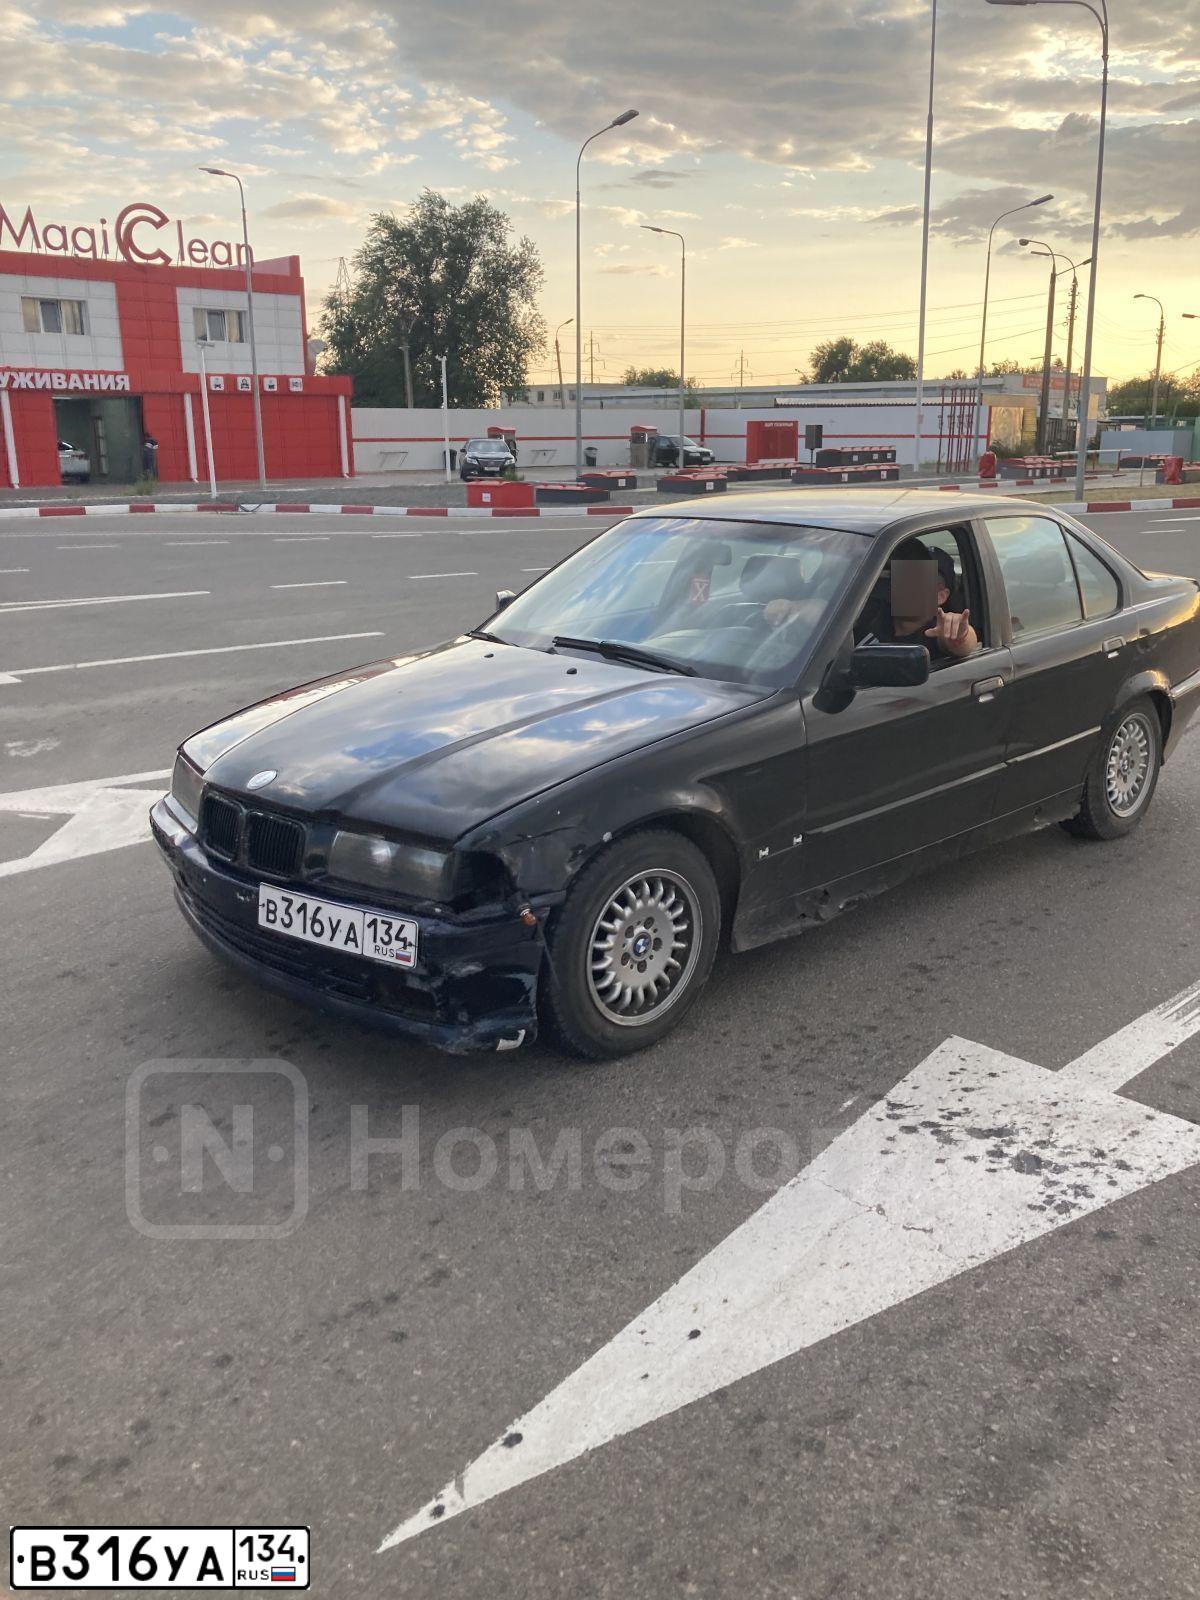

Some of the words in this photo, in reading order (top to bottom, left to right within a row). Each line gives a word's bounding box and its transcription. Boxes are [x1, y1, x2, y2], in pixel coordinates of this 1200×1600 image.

[266, 897, 359, 948] В316УА
[367, 918, 408, 950] 134
[374, 946, 395, 957] RUS
